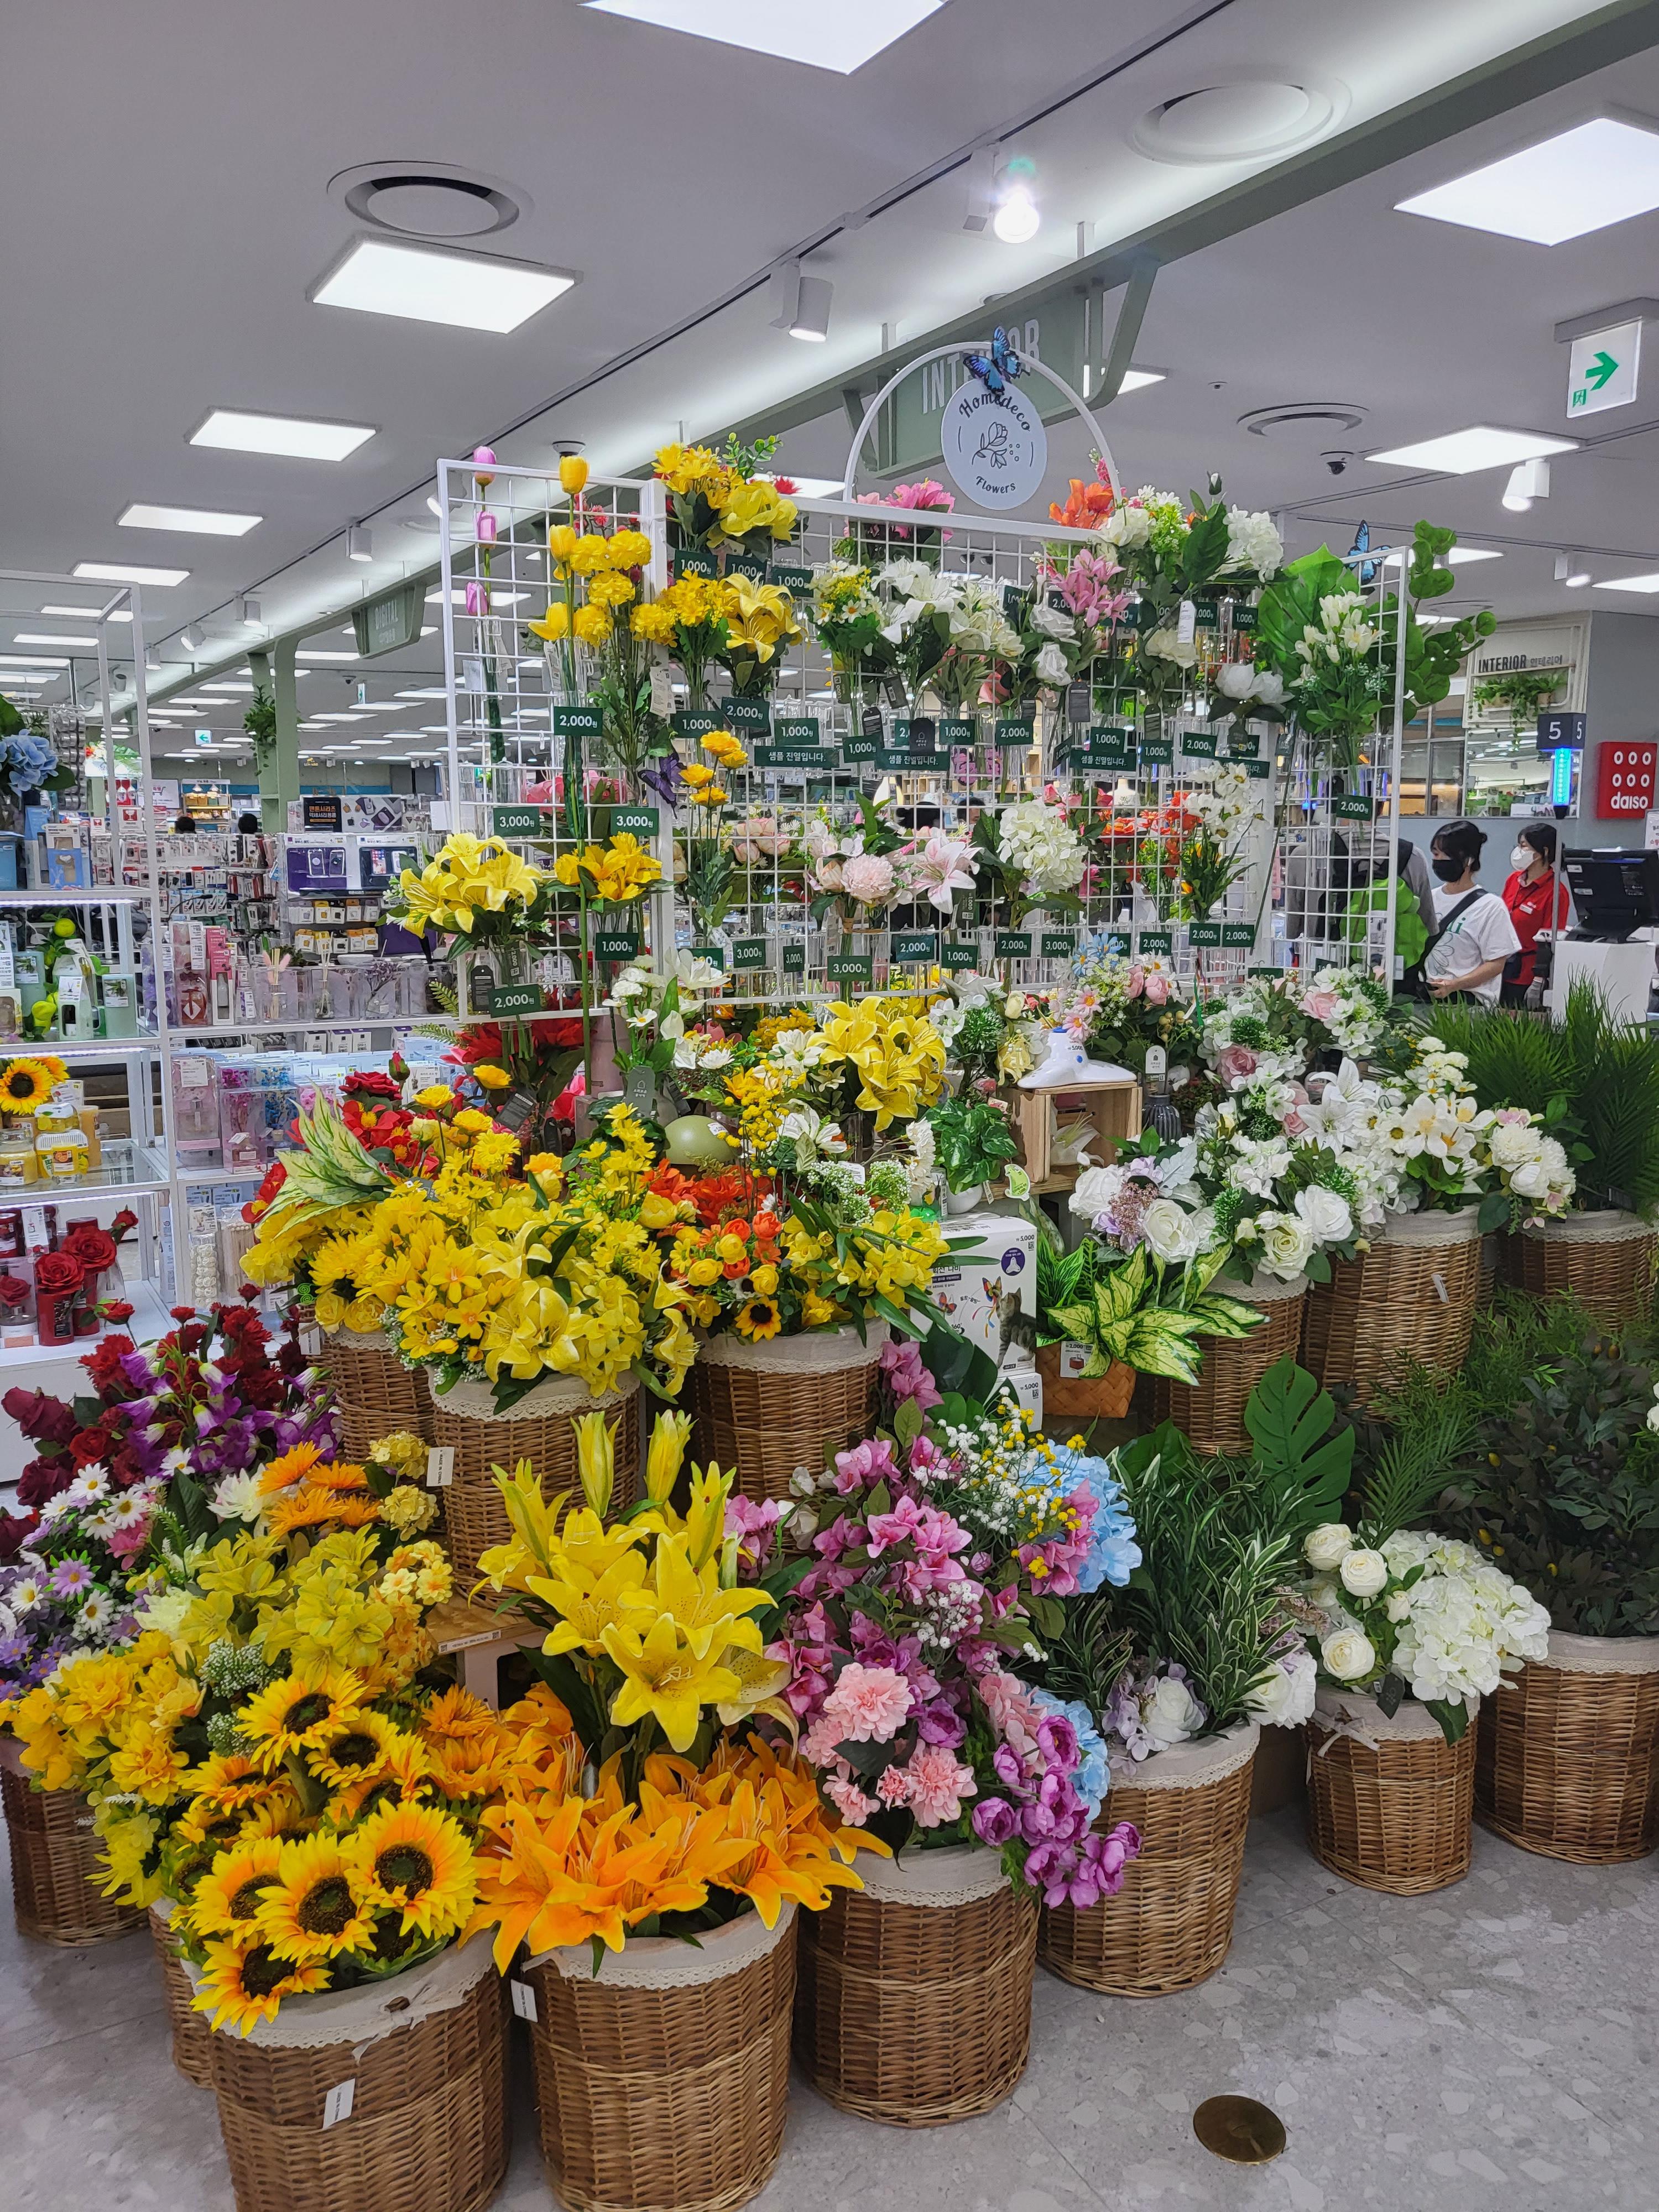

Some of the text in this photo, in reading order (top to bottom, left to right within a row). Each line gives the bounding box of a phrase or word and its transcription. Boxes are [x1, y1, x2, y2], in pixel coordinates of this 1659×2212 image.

[959, 393, 1030, 432] Homedeco
[976, 476, 1016, 493] Flowers
[732, 563, 757, 577] 1000
[778, 576, 804, 587] 1000
[1478, 654, 1563, 673] INTERIOR 인테리어
[727, 705, 763, 720] 2,000원
[559, 714, 597, 728] 2,000원
[681, 718, 717, 731] 1,000원
[780, 726, 813, 737] 1,000원
[945, 726, 971, 738] 1,000원
[1000, 727, 1029, 738] 2,000원
[1548, 721, 1561, 740] 5
[1576, 721, 1583, 740] 5
[1095, 734, 1119, 745] 1,000원
[1186, 739, 1211, 752] 2,000원
[848, 742, 877, 754] 1,000원
[1144, 747, 1167, 757] 1,000원
[768, 751, 826, 762] 샘플 진열입니다.
[889, 755, 902, 765] 샘플
[1081, 755, 1127, 766] 샘플 진열입니다.
[1610, 791, 1649, 810] daiso
[1340, 801, 1369, 814] 2,000원
[499, 815, 535, 828] 3,000원
[615, 815, 653, 828] 3,000원
[1192, 930, 1217, 940] 2,000원
[1225, 931, 1251, 940] 2,000원
[602, 941, 633, 952] 1,000원
[900, 942, 930, 952] 2,000원
[1001, 940, 1027, 950] 2,000원
[1045, 941, 1071, 951] 3,000원
[1142, 938, 1168, 950] 2,000원
[737, 947, 761, 959] 3,000원
[785, 953, 802, 964] 3,000원
[946, 951, 973, 962] 1,000원
[833, 963, 865, 974] 3,000원
[494, 994, 535, 1008] 2,000원
